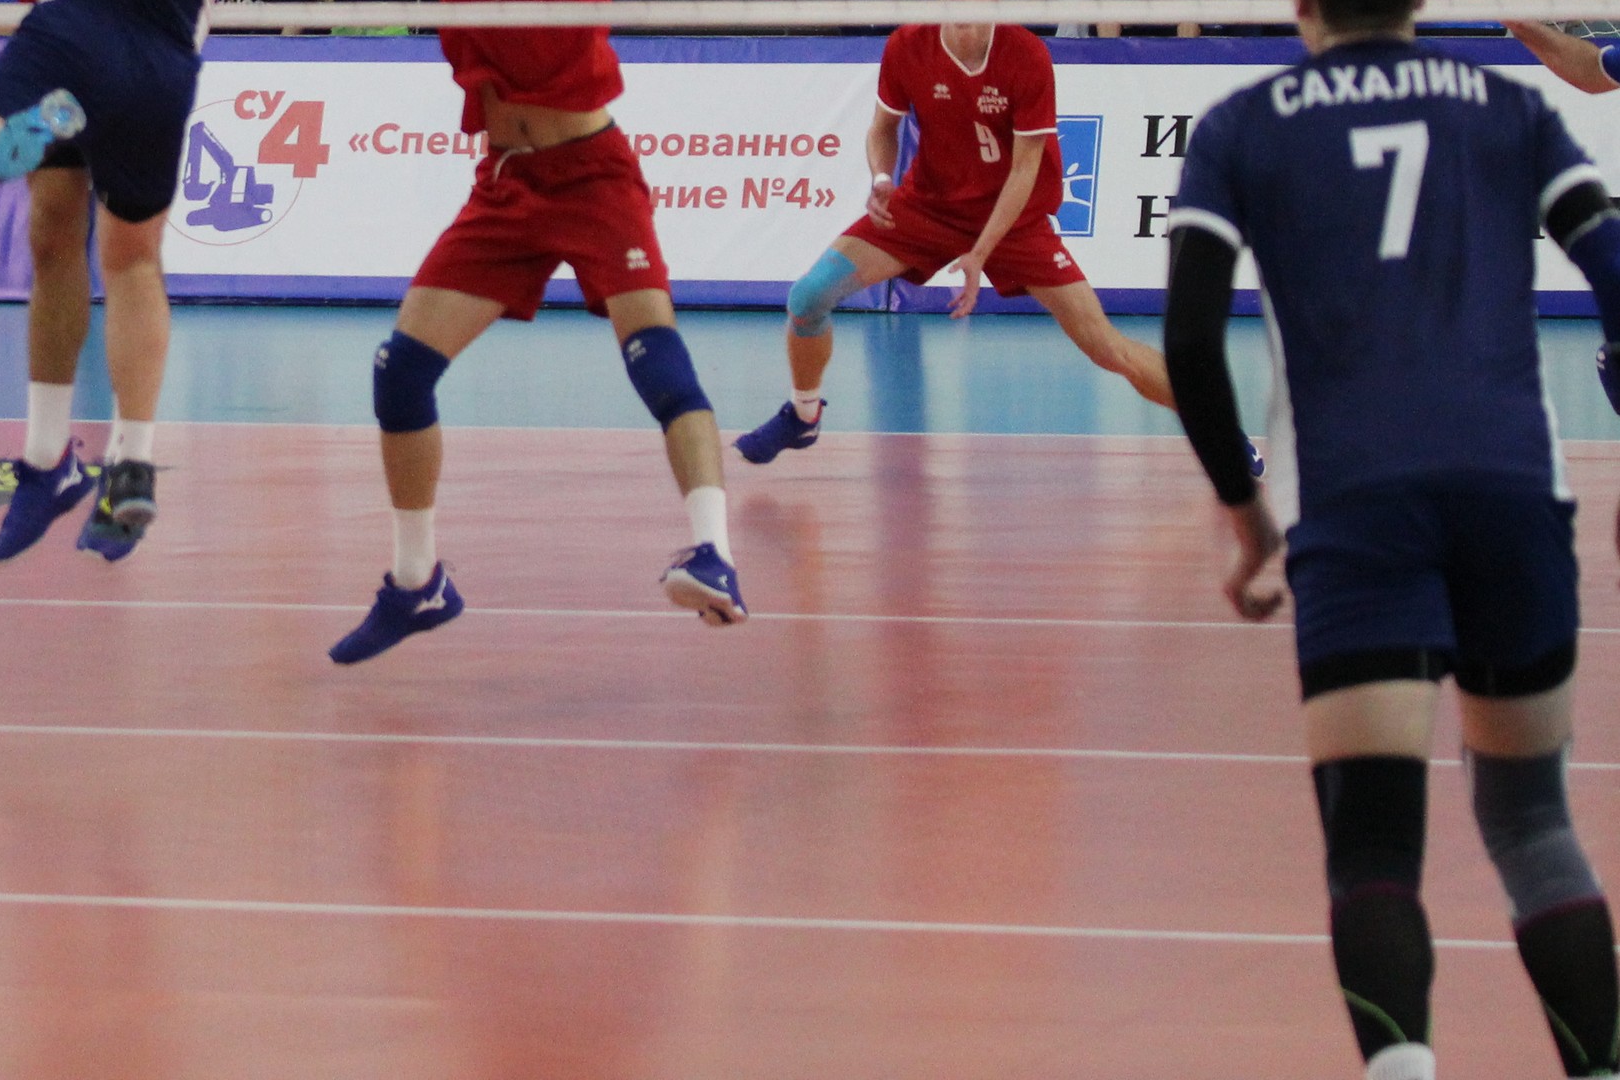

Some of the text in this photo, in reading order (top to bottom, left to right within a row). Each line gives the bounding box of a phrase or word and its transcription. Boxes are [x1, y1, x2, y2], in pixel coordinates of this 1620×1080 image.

[1270, 58, 1489, 118] САХАЛИН
[257, 101, 330, 179] 4
[973, 120, 1001, 163] 9
[741, 177, 836, 209] №4»
[1348, 120, 1430, 262] 7
